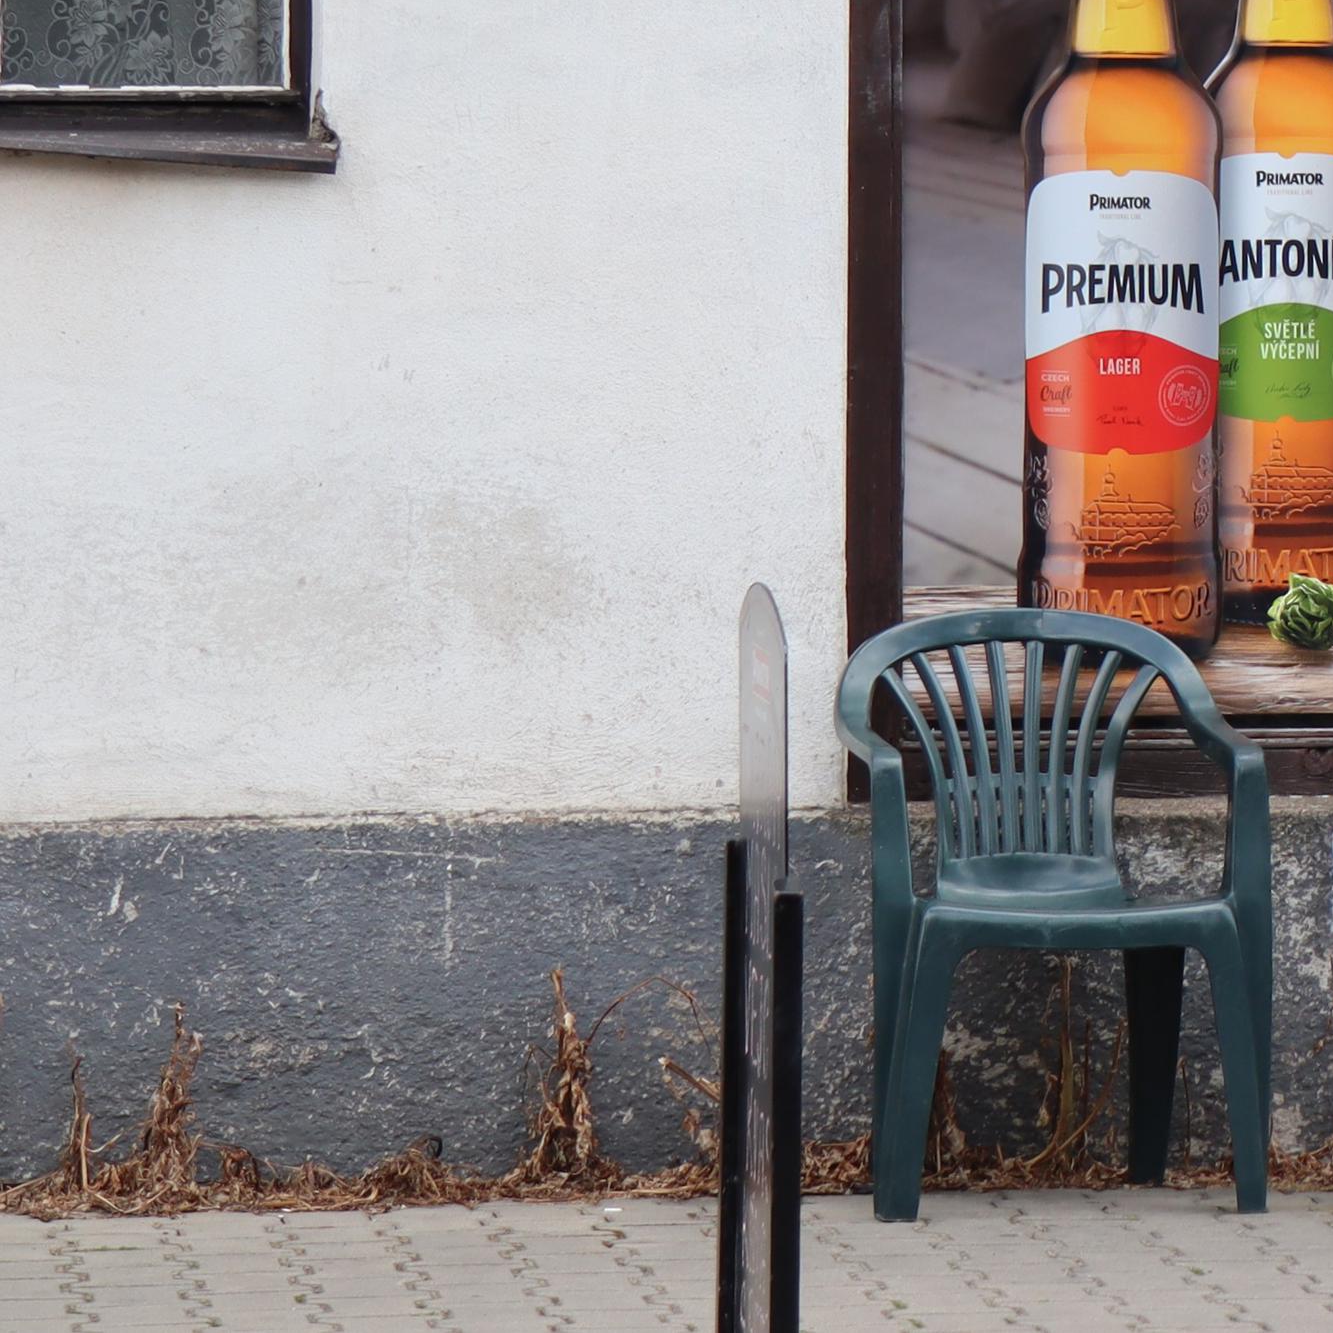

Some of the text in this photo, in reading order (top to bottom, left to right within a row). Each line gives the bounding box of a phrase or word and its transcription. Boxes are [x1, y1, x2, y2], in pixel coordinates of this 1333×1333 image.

[1255, 171, 1324, 187] PRIMATOR
[1089, 194, 1151, 211] PRIMATOR
[1041, 263, 1205, 315] PREMIUM
[1264, 319, 1316, 339] SVĚTLÉ
[1260, 340, 1320, 360] VÝČEPNÍ
[1100, 358, 1140, 375] LAGER
[1041, 374, 1070, 382] CZECH
[1040, 384, 1072, 405] Craft
